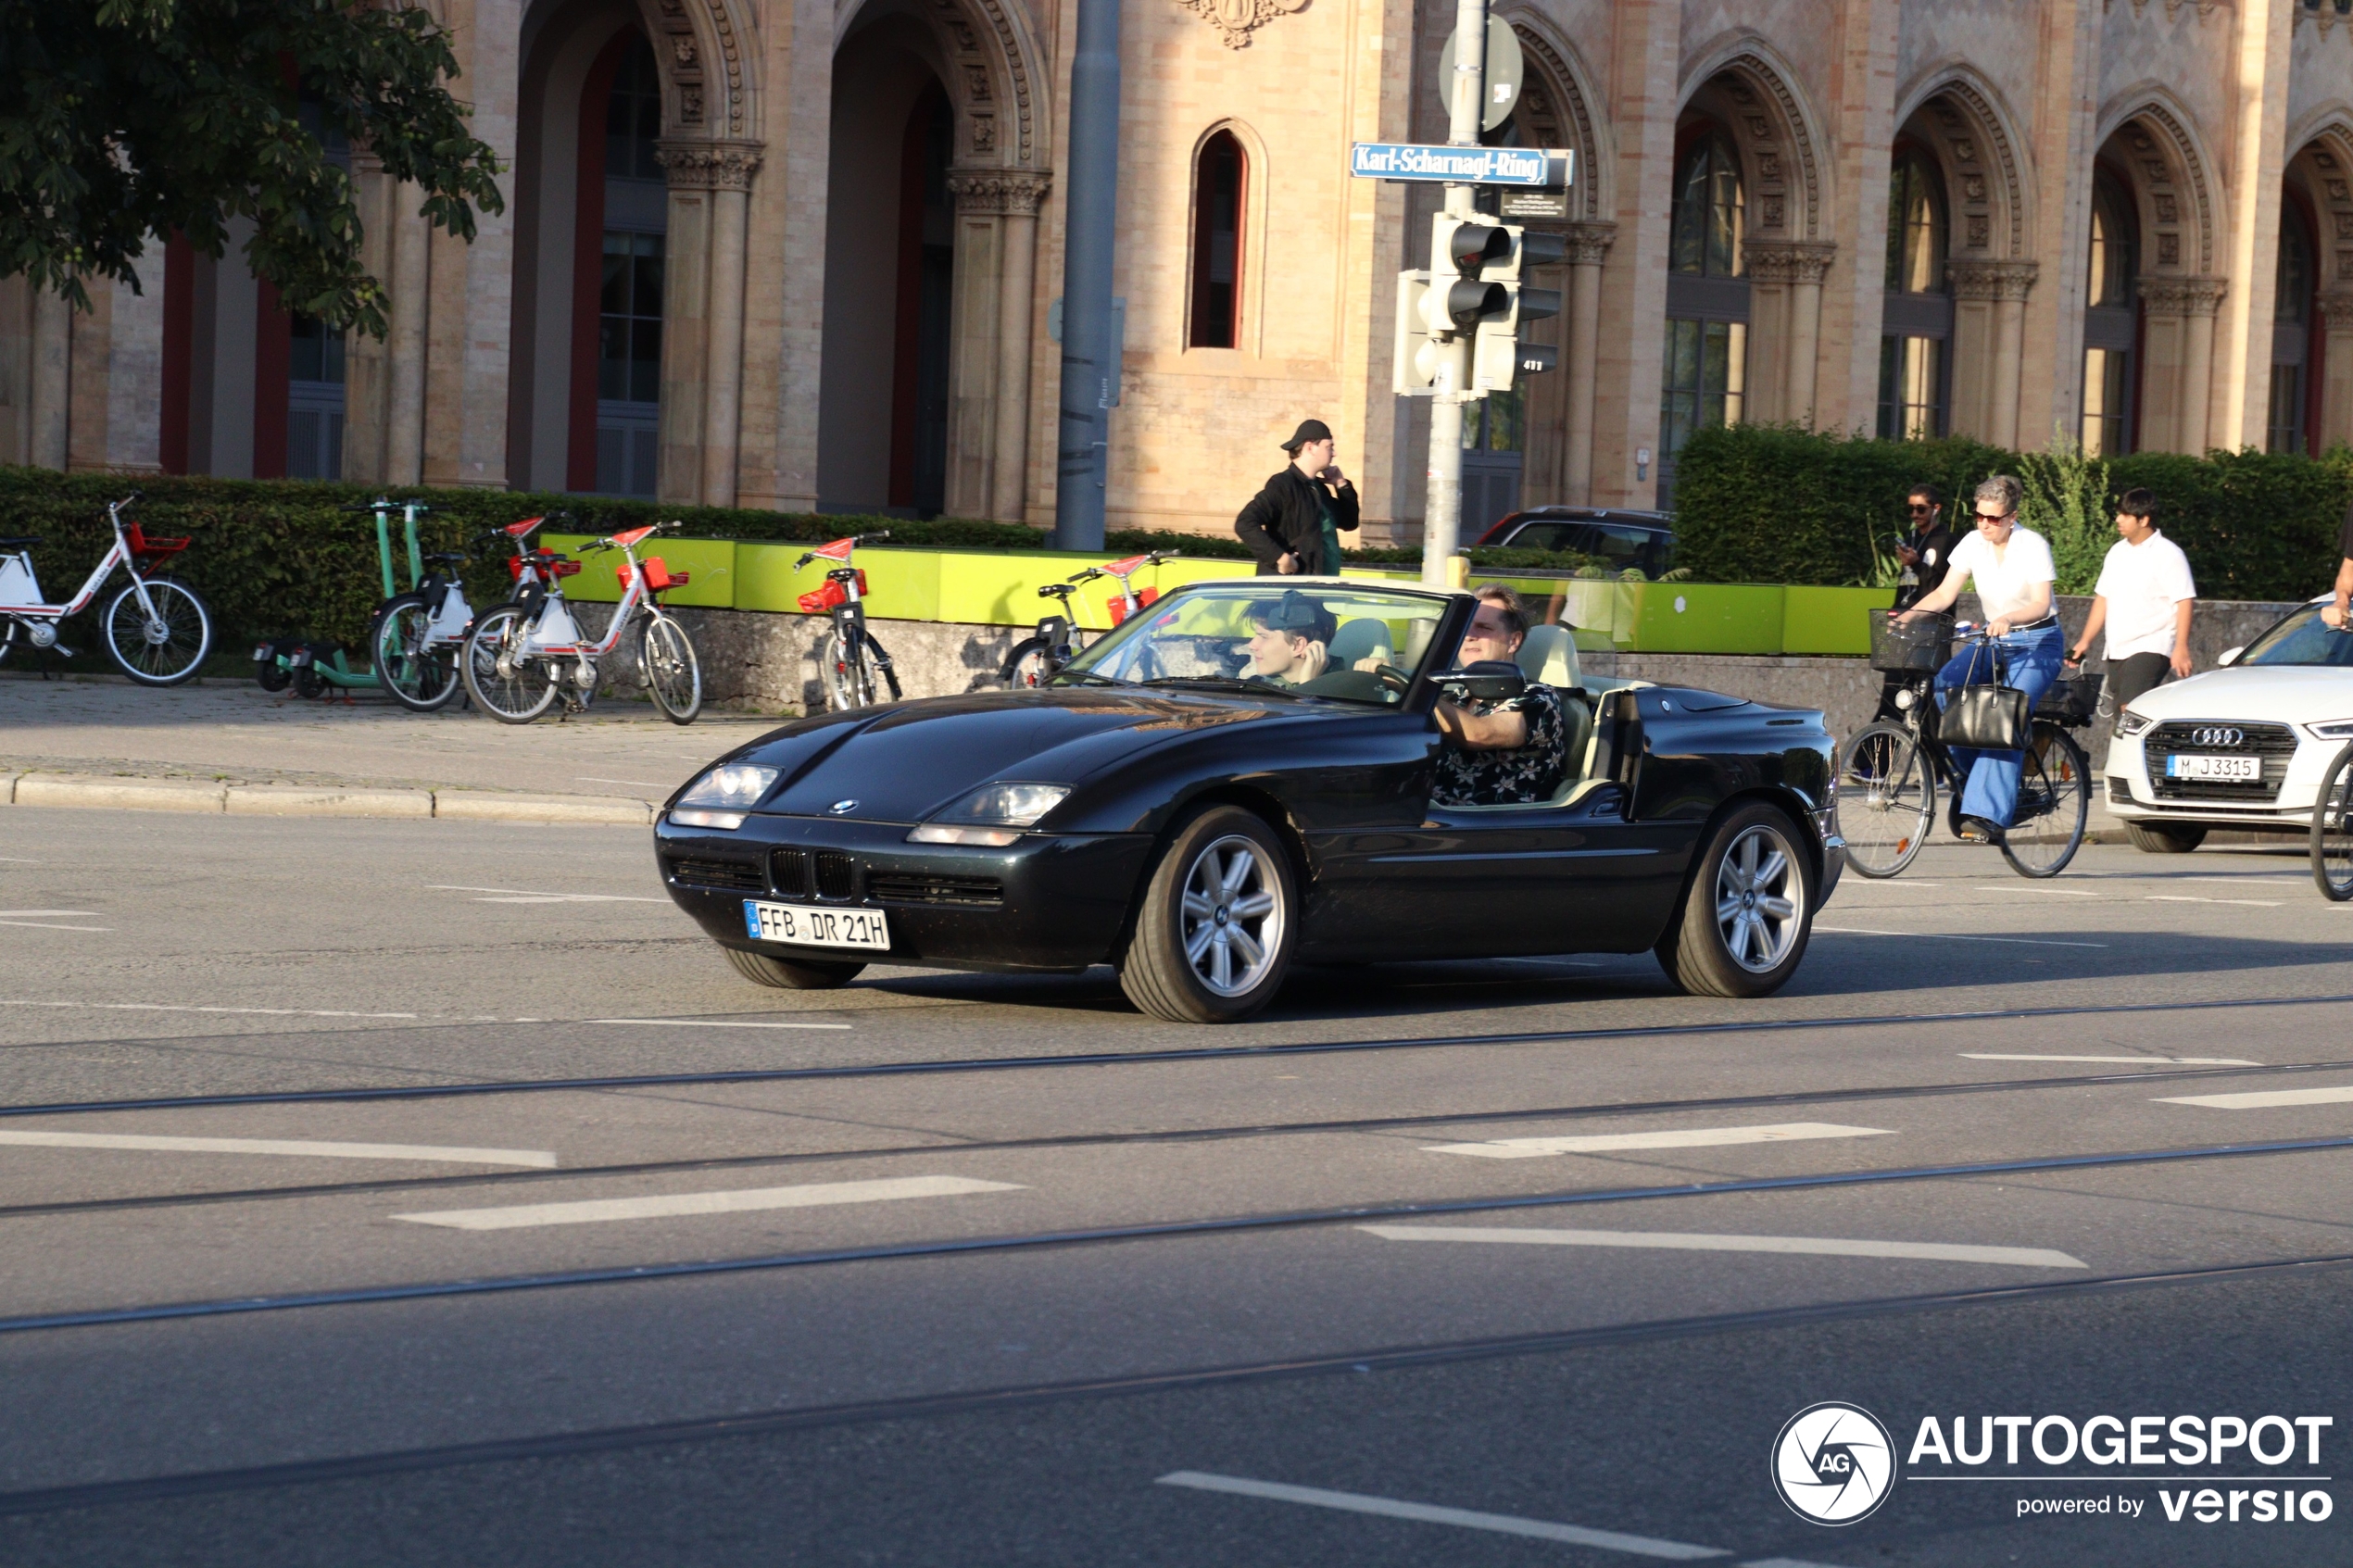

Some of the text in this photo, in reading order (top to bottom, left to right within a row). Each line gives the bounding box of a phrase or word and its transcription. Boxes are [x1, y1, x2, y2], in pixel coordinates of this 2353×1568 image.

[1357, 146, 1540, 182] Karl-Scharnagl-Ring
[1523, 359, 1542, 371] 411
[2181, 759, 2251, 776] M J 3315
[759, 907, 885, 944] FFB DR 21H
